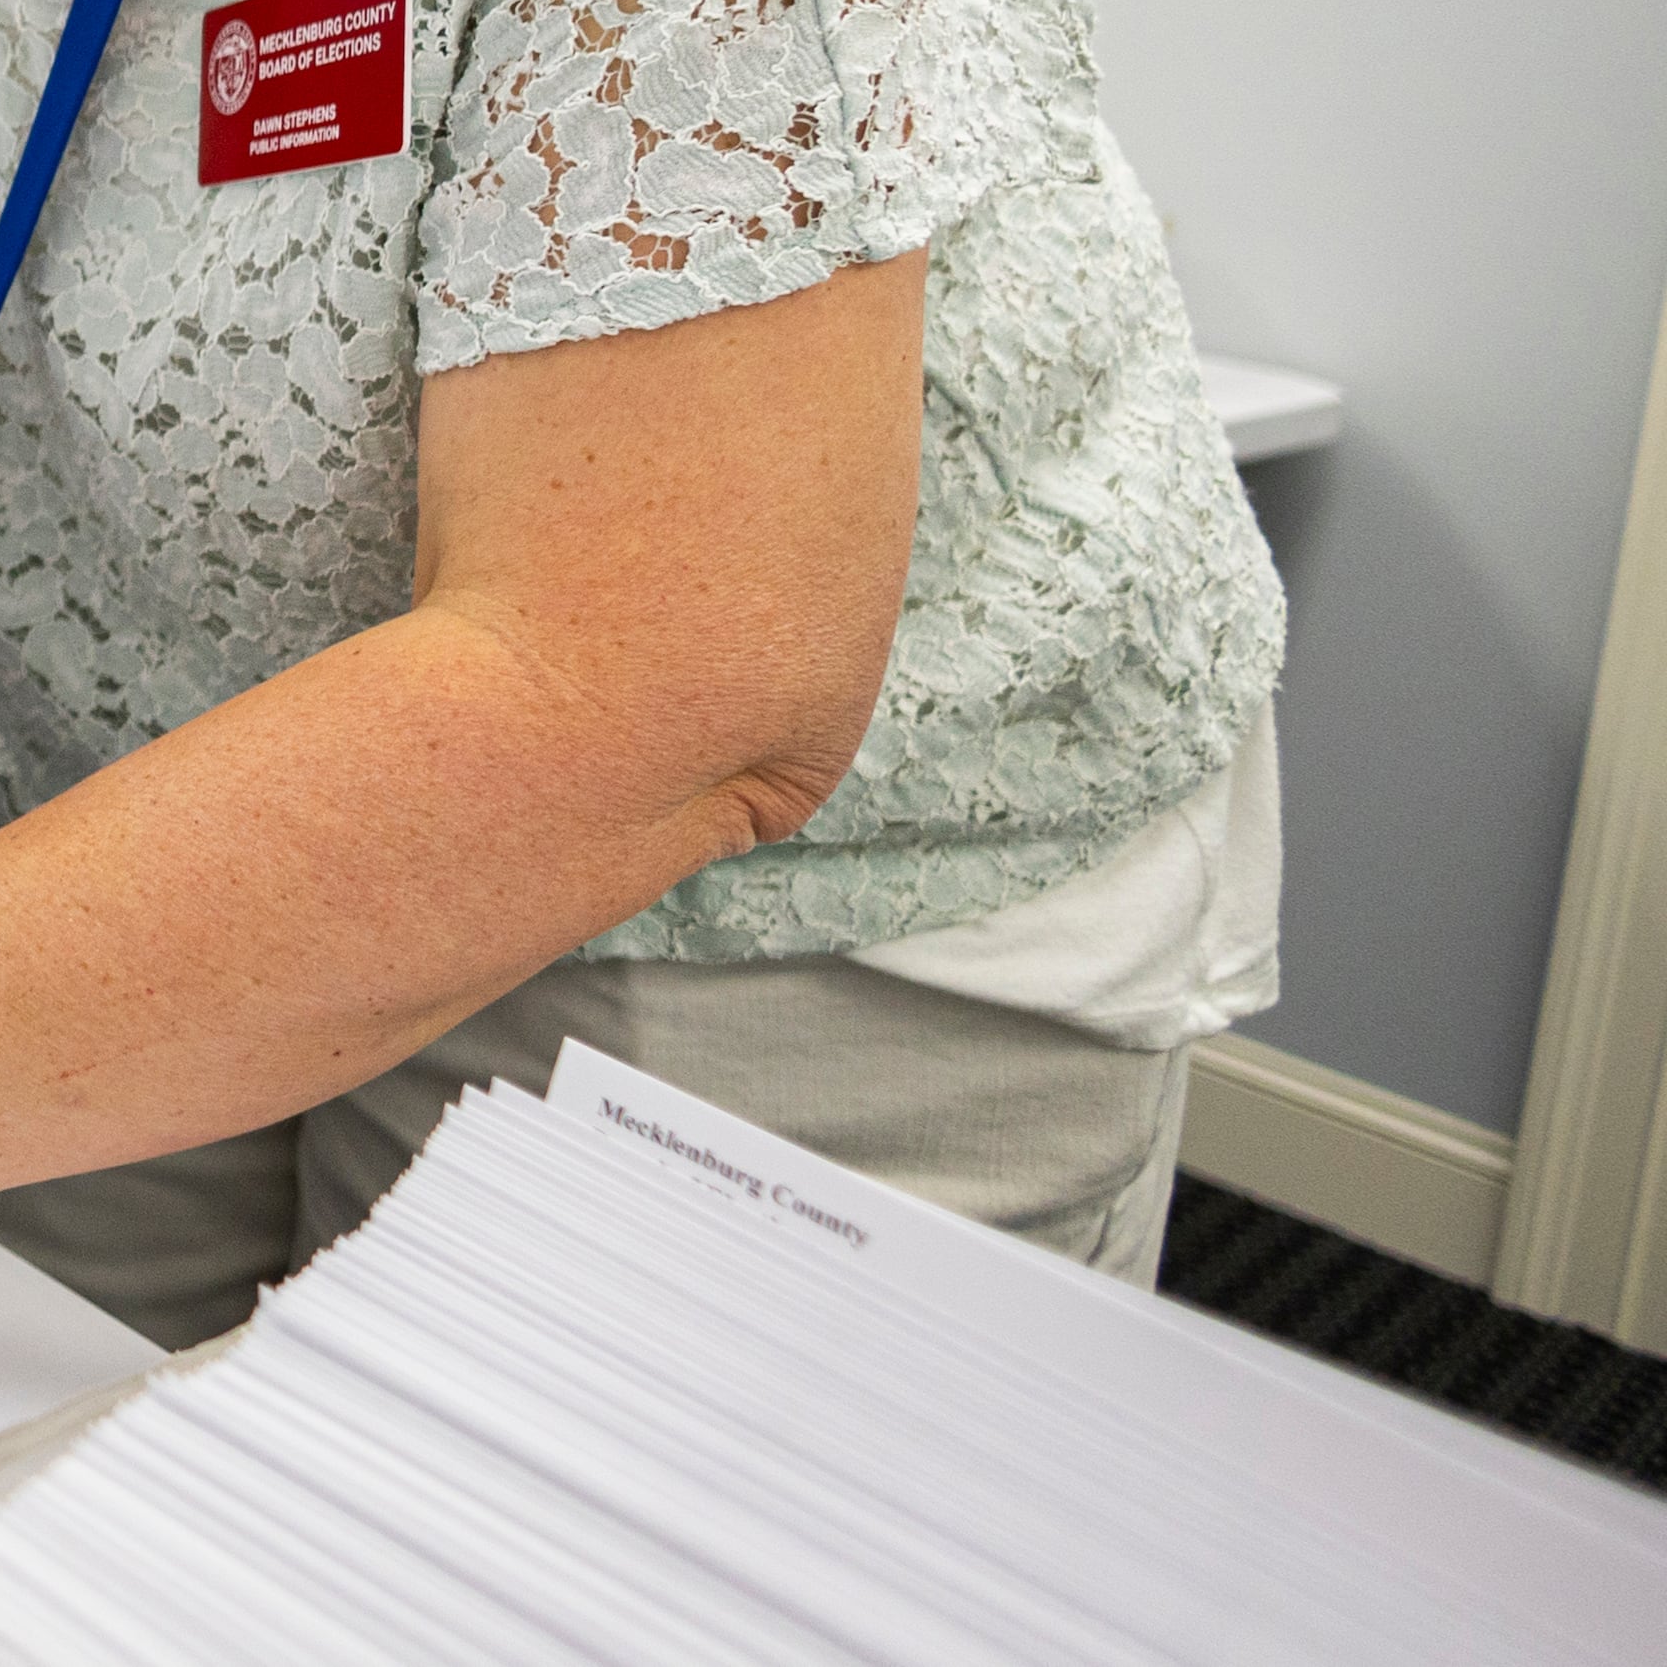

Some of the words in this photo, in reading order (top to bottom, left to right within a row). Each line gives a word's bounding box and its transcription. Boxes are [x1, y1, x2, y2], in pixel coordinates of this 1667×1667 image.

[259, 16, 342, 56] MECKLENBURG
[344, 0, 397, 31] COUNTY
[258, 52, 296, 81] BOARD
[297, 49, 314, 71] OF
[315, 32, 381, 66] ELECTIONS
[249, 134, 279, 156] PUBLIC
[279, 124, 340, 151] INFORMATION
[253, 114, 282, 137] DAWN
[283, 103, 337, 130] STEPHENS
[598, 1096, 763, 1199] Mecklenburg
[772, 1183, 873, 1250] County
